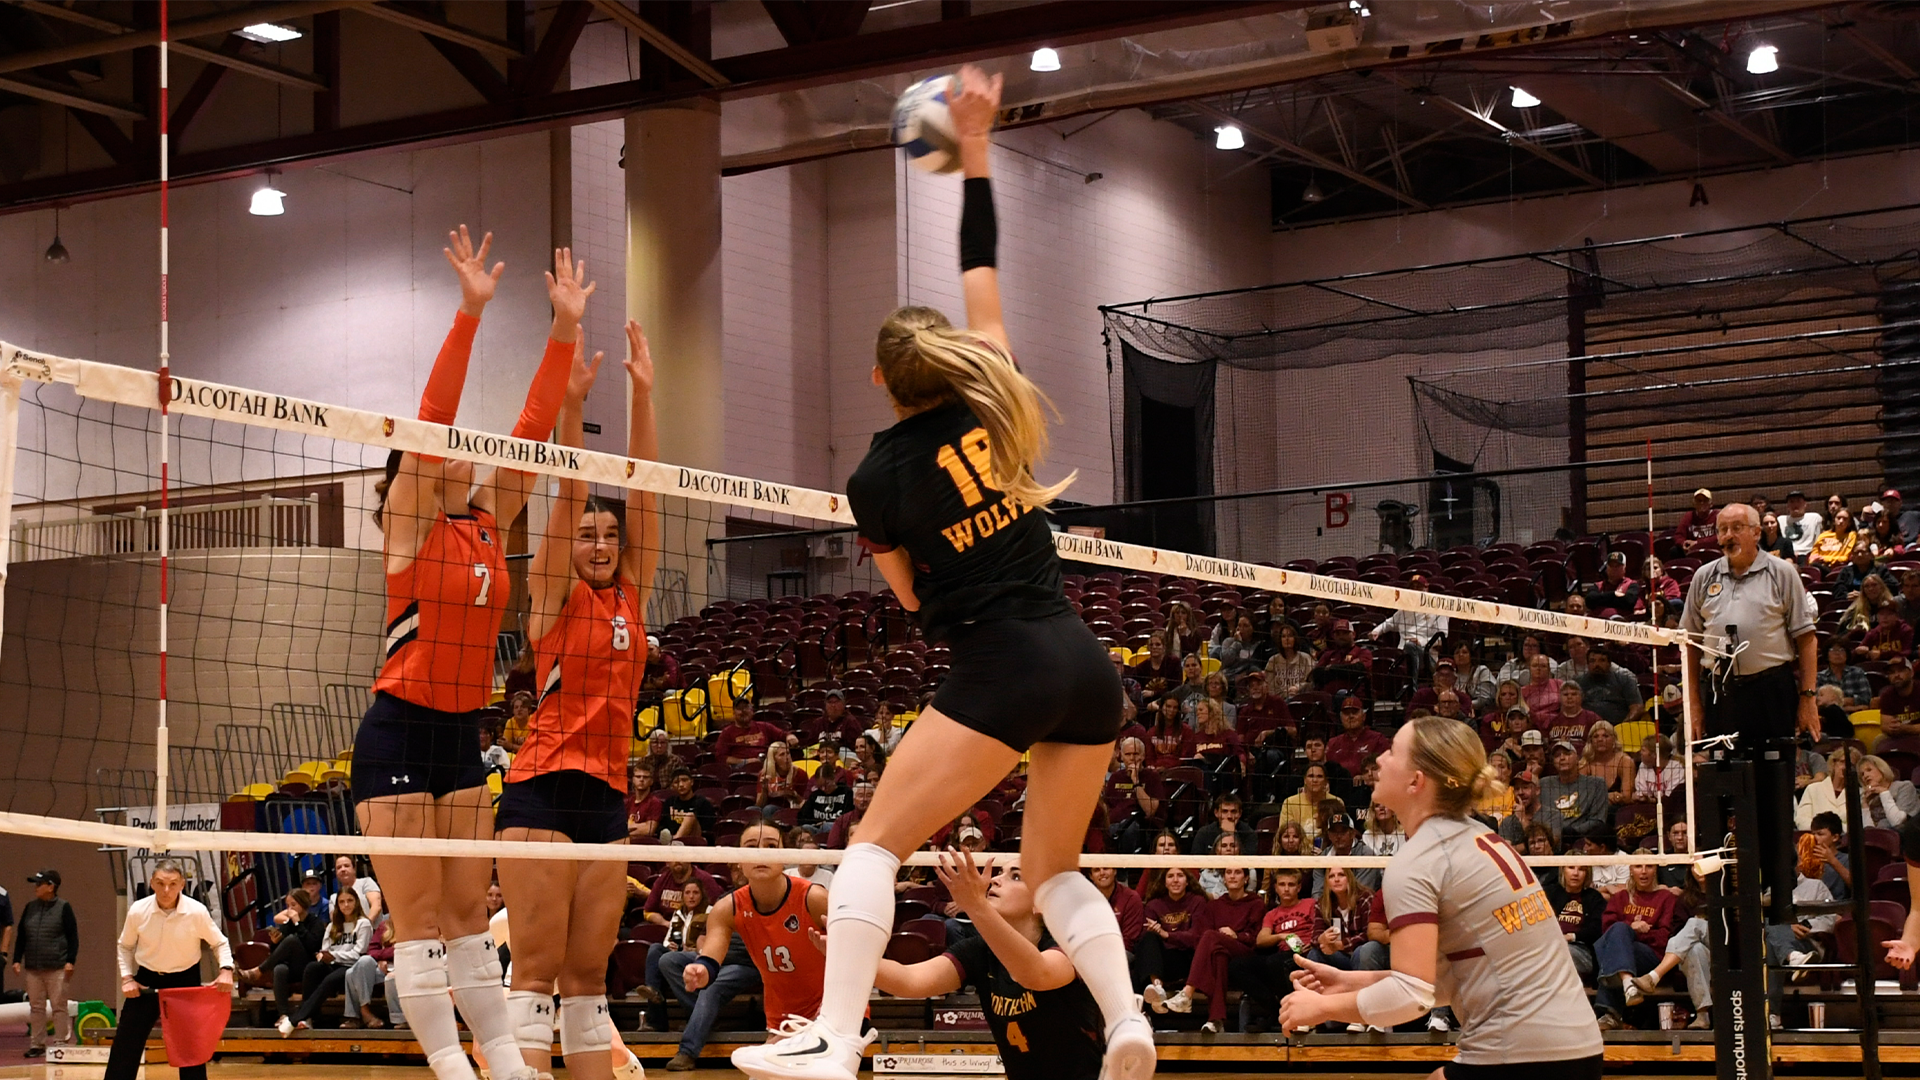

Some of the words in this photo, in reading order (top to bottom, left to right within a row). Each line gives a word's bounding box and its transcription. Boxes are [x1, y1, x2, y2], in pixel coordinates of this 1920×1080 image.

[170, 377, 267, 417] DACOTAH
[273, 396, 328, 427] BANK
[448, 427, 529, 462] DACOTAH
[534, 442, 580, 470] BANK
[678, 468, 748, 498] DACOTAH
[753, 481, 790, 505] BANK
[941, 496, 1033, 553] WOLV
[1325, 493, 1350, 528] B
[1051, 535, 1092, 555] COTAH
[1095, 540, 1123, 560] BANK
[1186, 555, 1229, 577] DACOTAH
[1232, 562, 1256, 581] BANK
[474, 563, 490, 605] 7
[1310, 575, 1349, 594] DACOTAH
[1351, 582, 1373, 599] BANK
[1420, 593, 1454, 611] DACOTAH
[1456, 599, 1476, 614] BANK
[1518, 608, 1549, 625] DACOTAH
[132, 817, 156, 830] Pro
[169, 814, 216, 831] member
[1475, 832, 1535, 893] 17
[1623, 904, 1656, 917] ORTHER
[763, 945, 796, 973] 13
[990, 991, 1038, 1016] ORTHERN
[1730, 990, 1745, 1031] sports
[1006, 1021, 1030, 1053] 4
[942, 1057, 957, 1066] this
[959, 1058, 967, 1066] is
[969, 1057, 992, 1071] living!
[1732, 1033, 1748, 1080] imports
